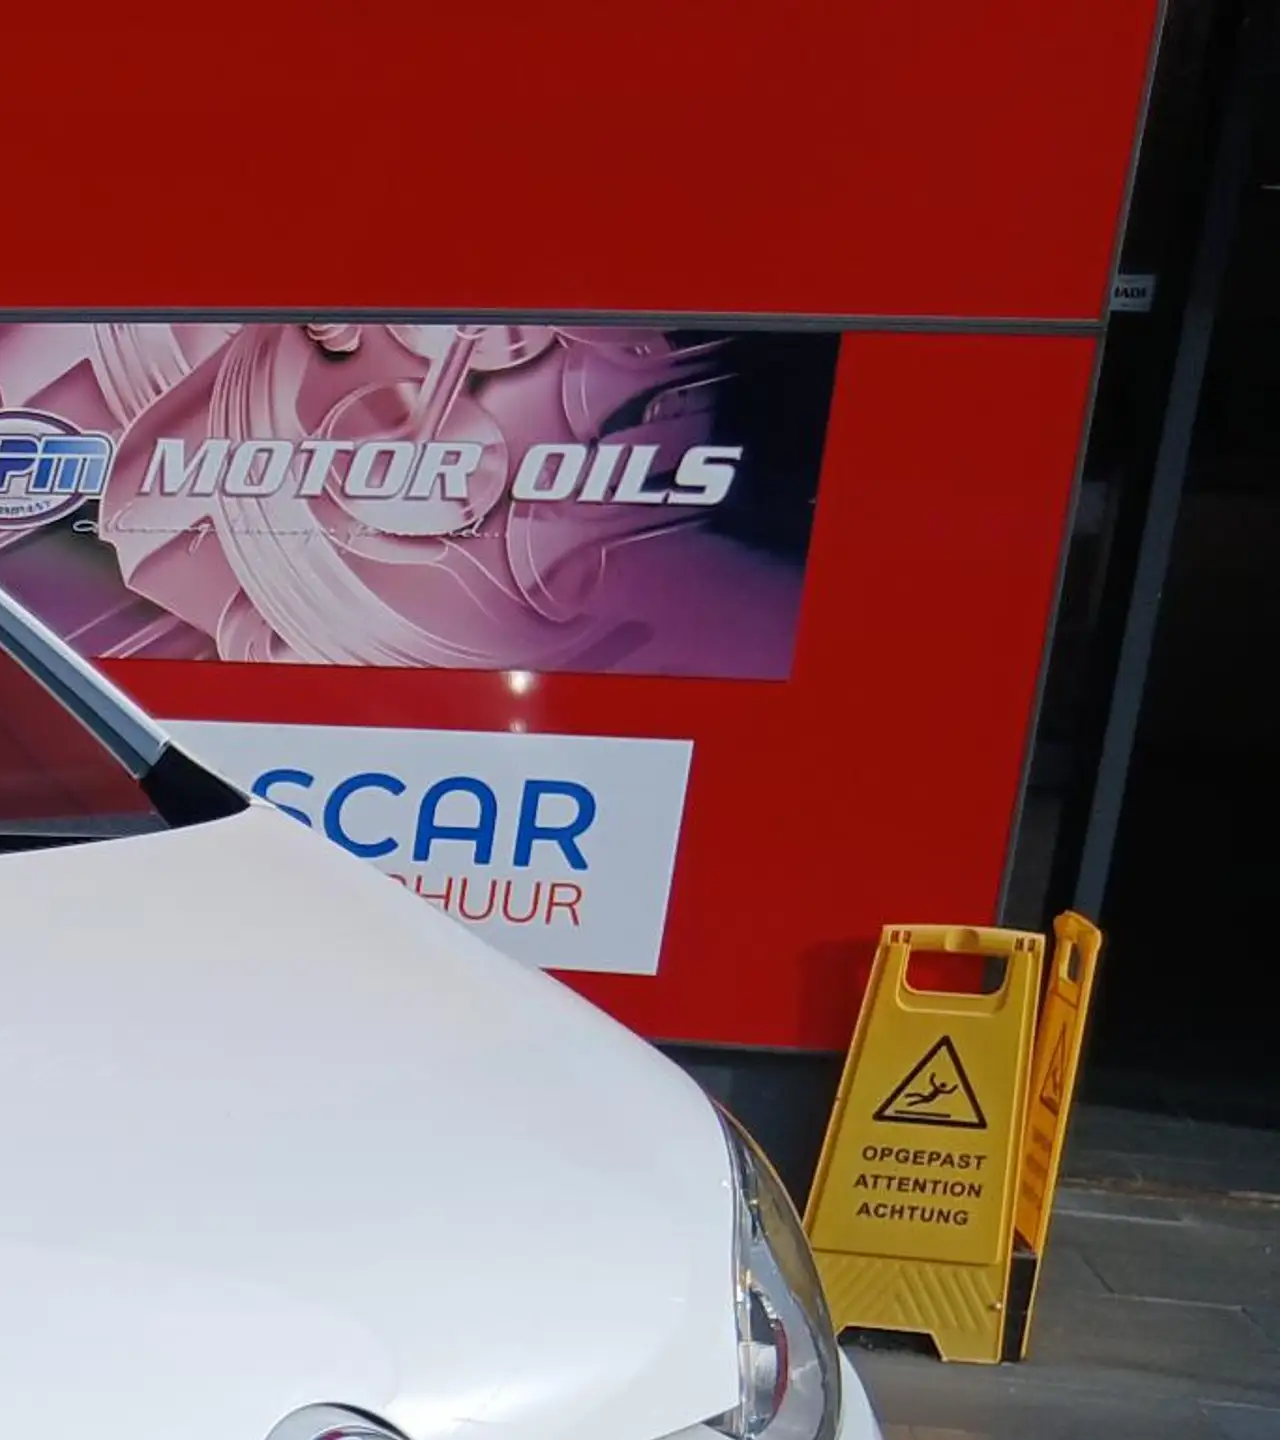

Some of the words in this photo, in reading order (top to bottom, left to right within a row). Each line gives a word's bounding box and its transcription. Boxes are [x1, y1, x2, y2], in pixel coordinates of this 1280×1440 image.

[140, 437, 476, 501] MOTOR
[509, 443, 743, 506] OILS
[861, 1146, 987, 1171] OPGEPAST
[854, 1173, 983, 1198] ATTENTION
[856, 1202, 969, 1226] ACHTUNG
